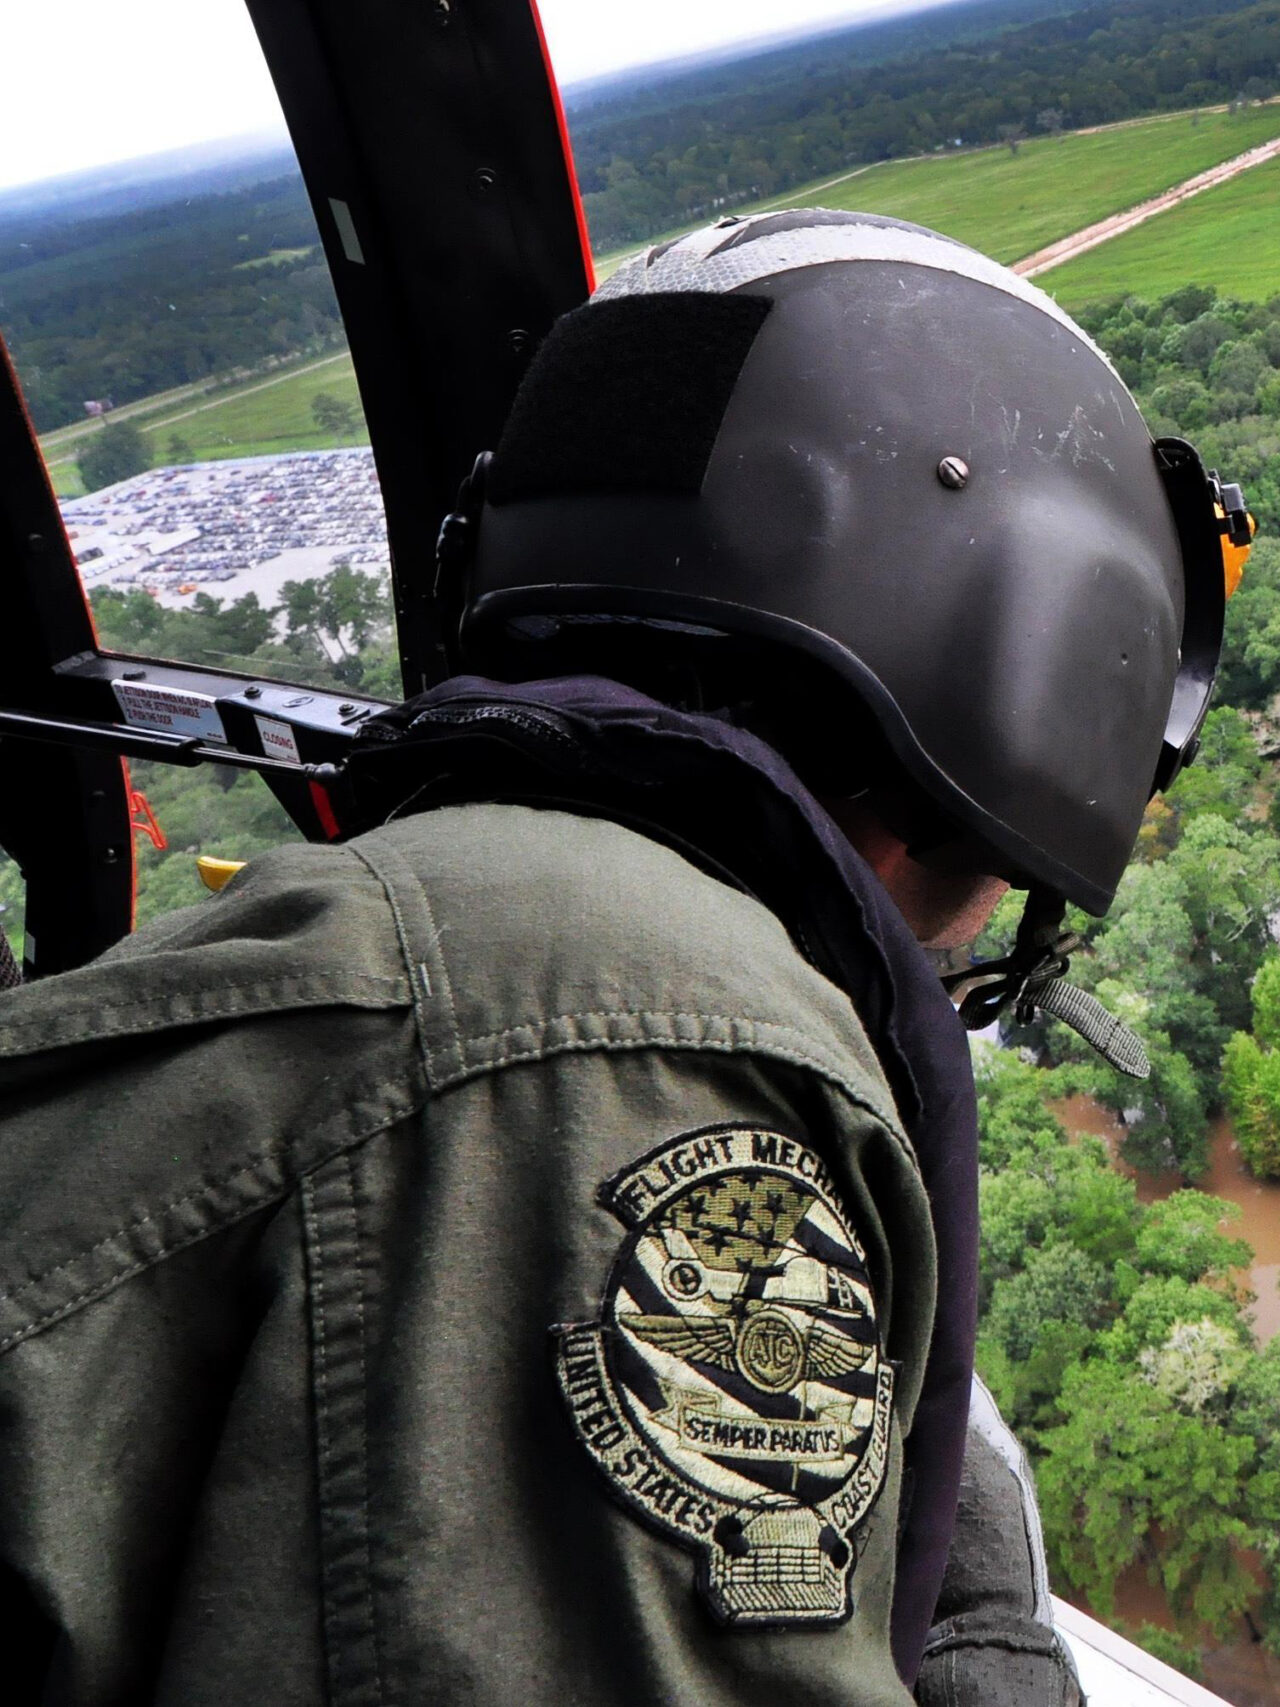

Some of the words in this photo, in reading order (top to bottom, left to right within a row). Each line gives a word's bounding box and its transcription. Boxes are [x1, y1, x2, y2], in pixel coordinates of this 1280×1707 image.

[262, 730, 294, 750] CLOSING
[620, 1135, 733, 1214] FLIGHT
[565, 1329, 626, 1450] UNITED
[613, 1448, 716, 1534] STATES
[686, 1417, 767, 1450] SEMPER
[831, 1457, 878, 1530] COAST
[872, 1371, 892, 1461] GUARD
